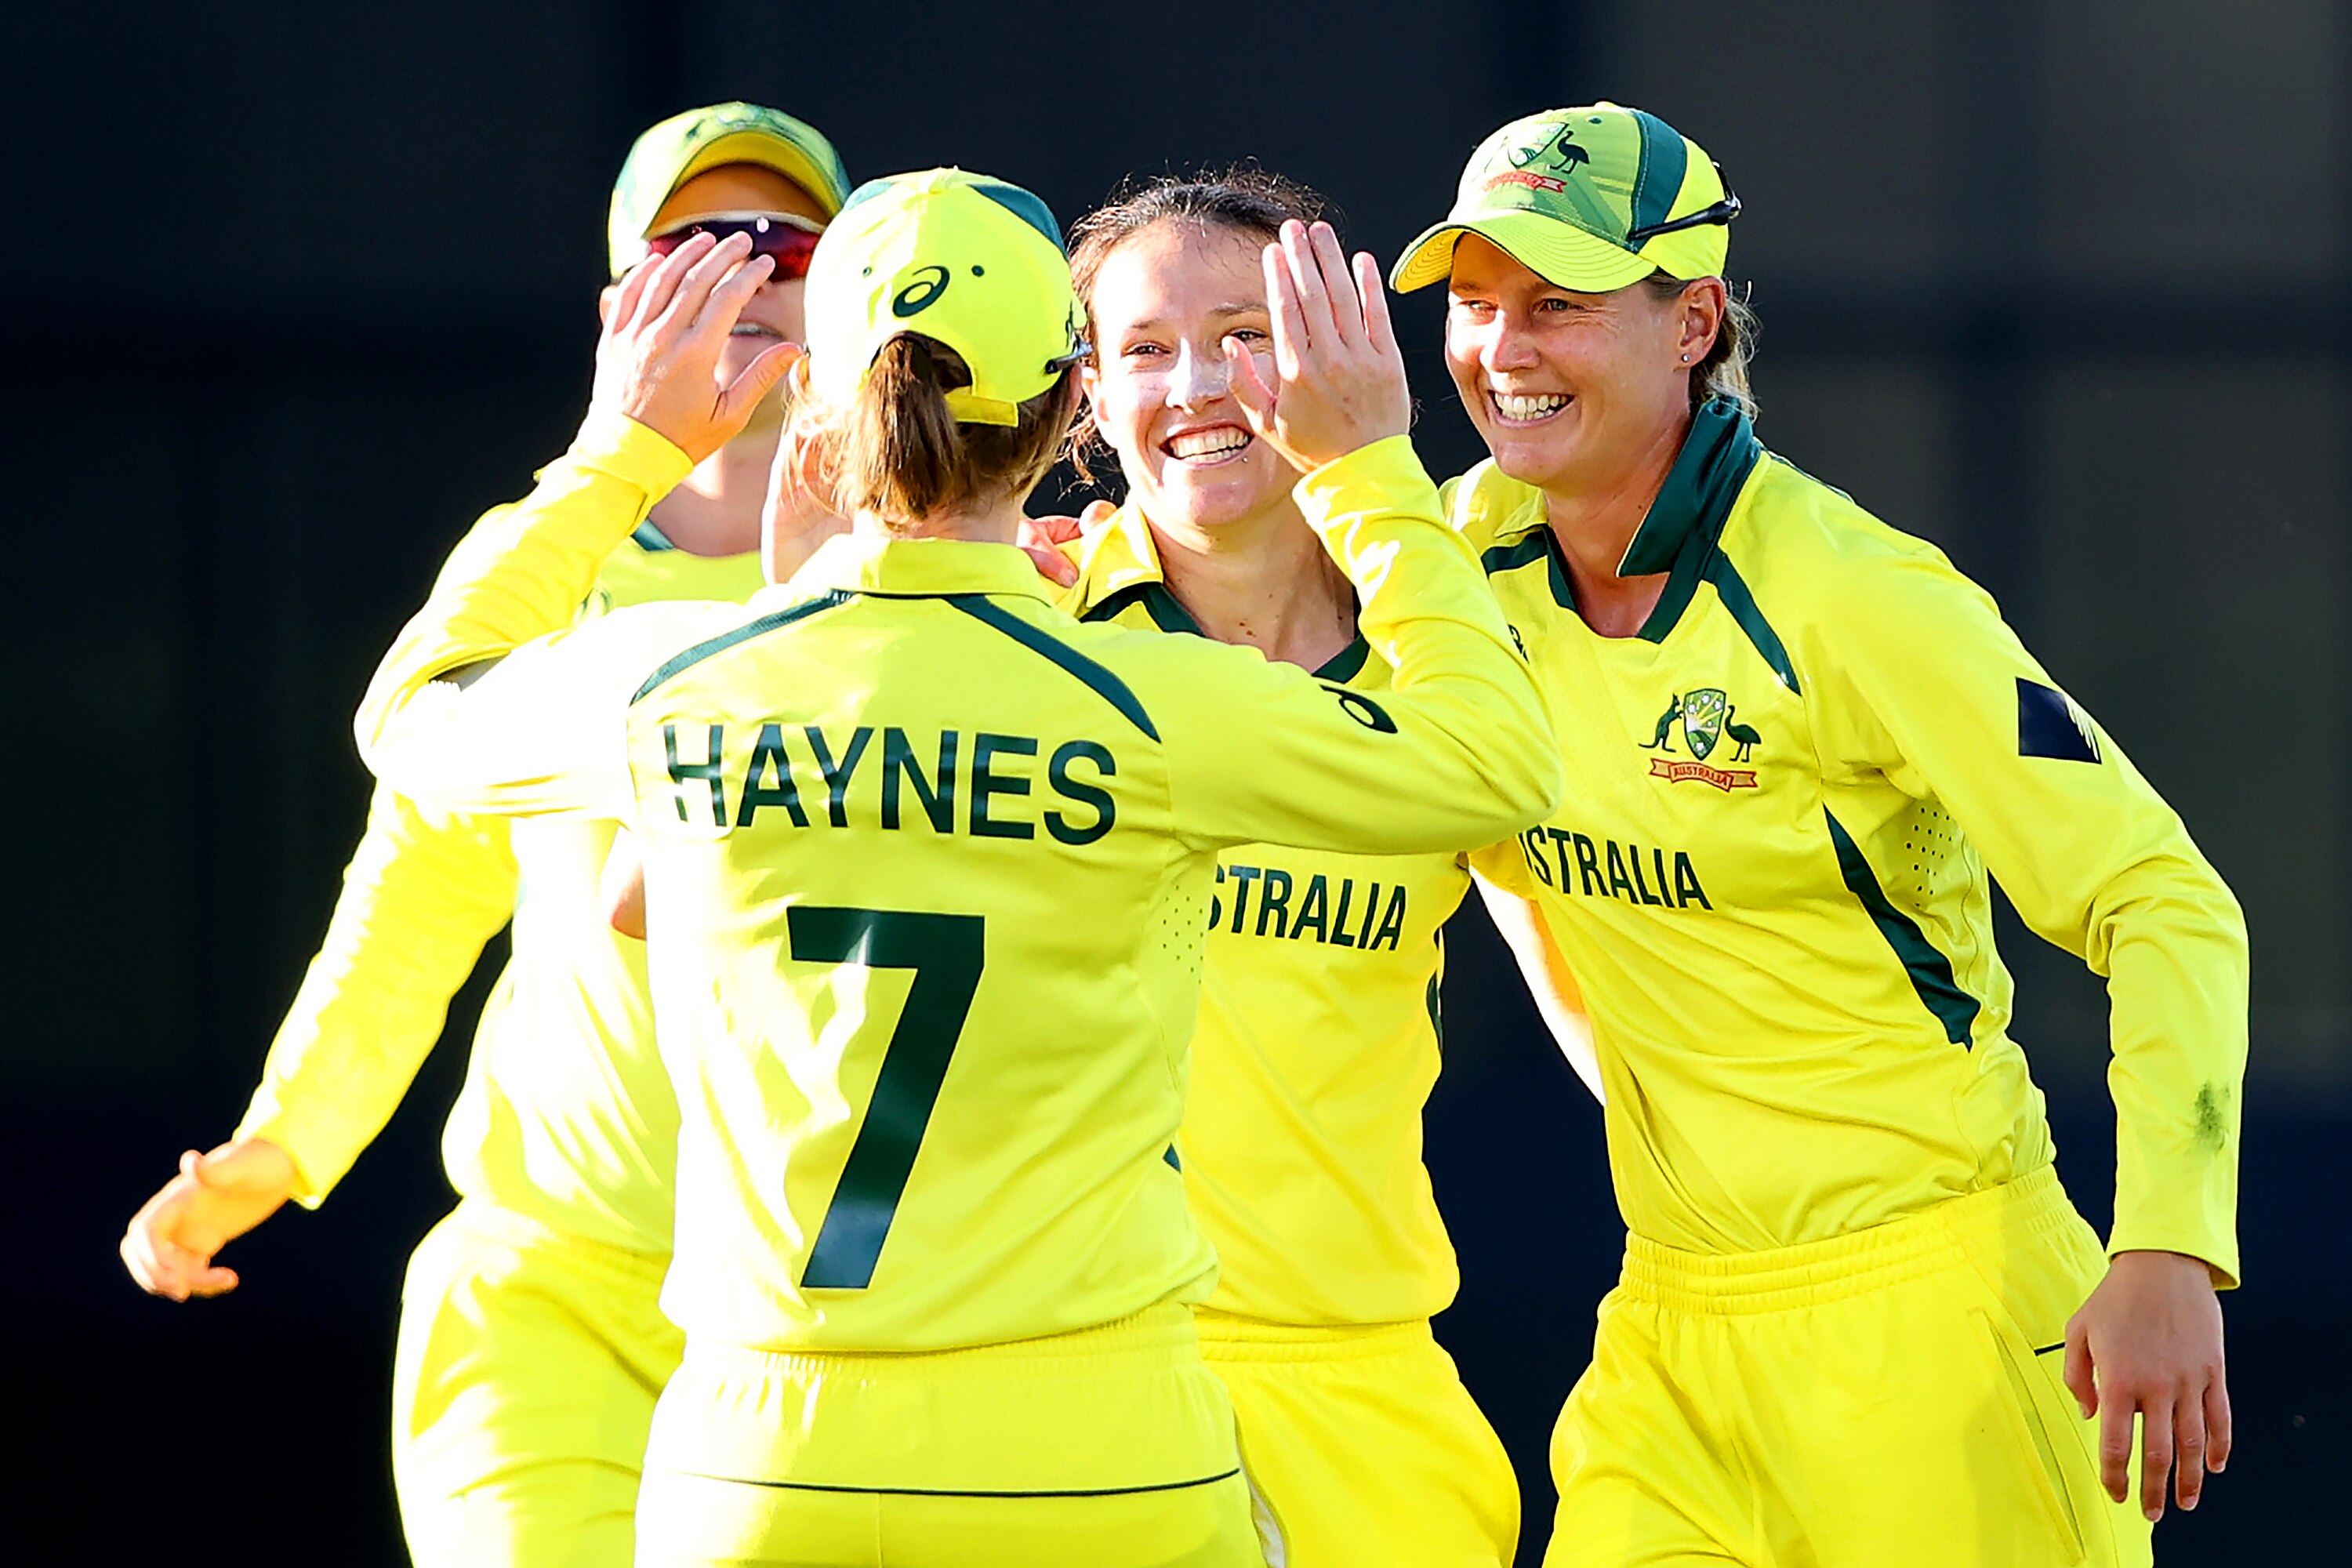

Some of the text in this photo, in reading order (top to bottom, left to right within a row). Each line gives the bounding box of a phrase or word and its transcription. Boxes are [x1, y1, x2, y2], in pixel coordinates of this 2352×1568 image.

[663, 724, 1116, 846] HAYNES
[1674, 766, 1727, 786] AUSTRALIA
[786, 906, 985, 1289] 7
